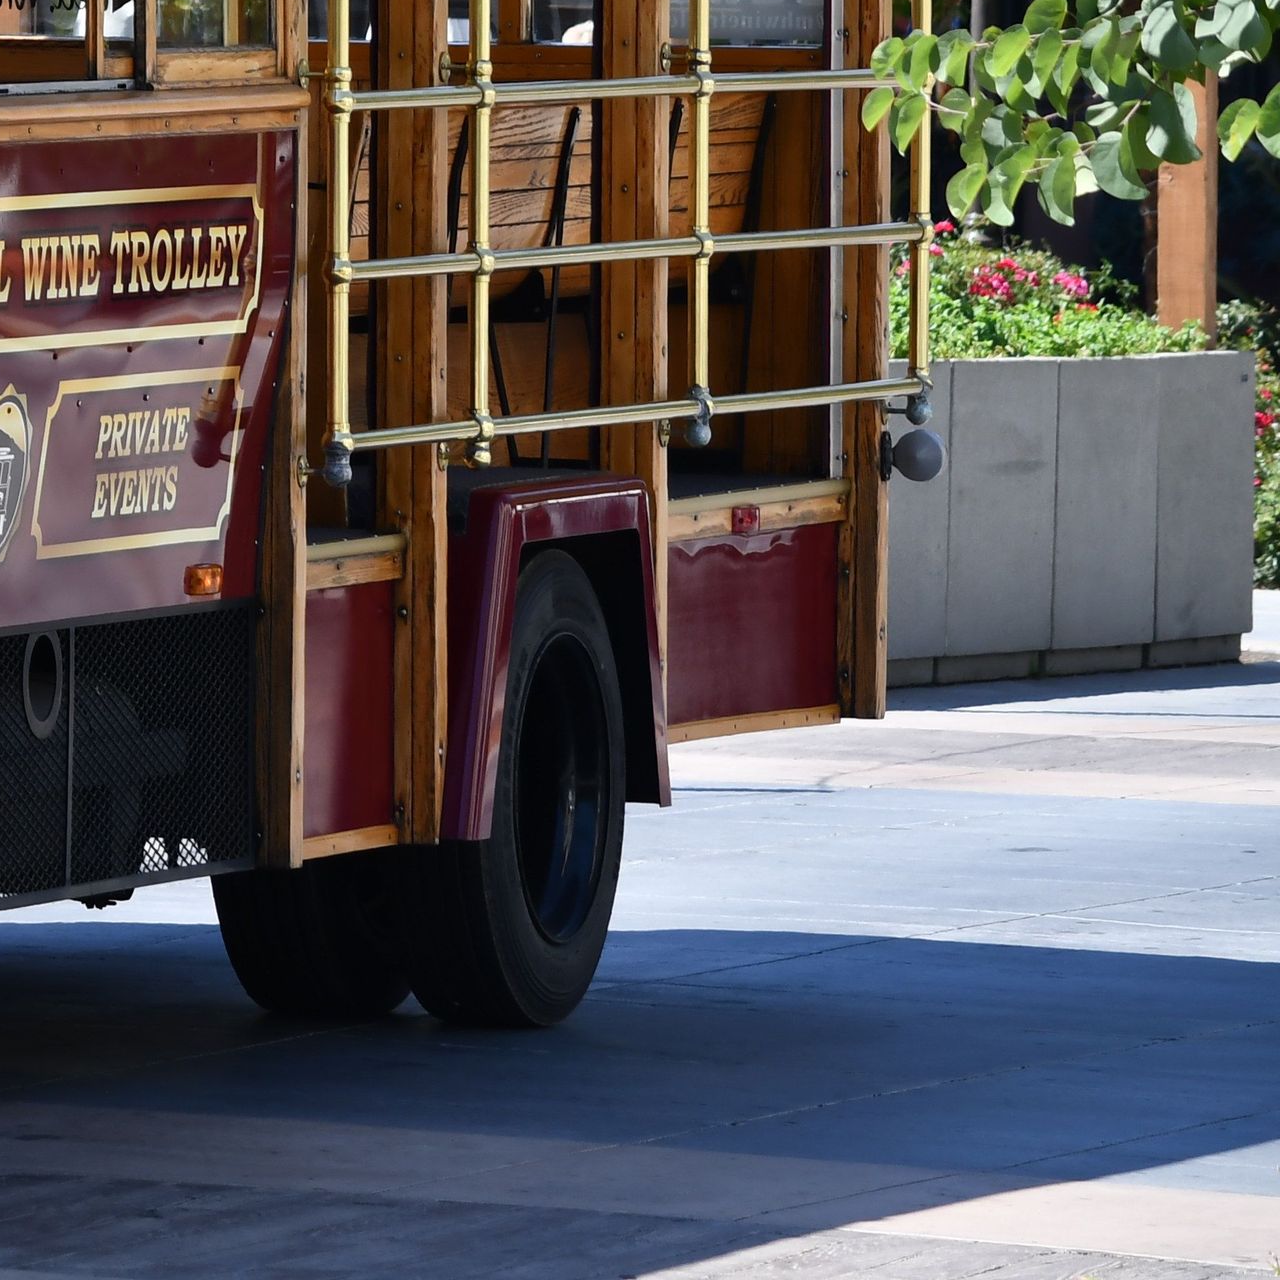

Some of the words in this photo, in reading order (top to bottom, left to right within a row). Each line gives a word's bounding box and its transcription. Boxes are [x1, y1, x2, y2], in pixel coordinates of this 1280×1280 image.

[21, 233, 101, 302] WINE
[110, 225, 247, 294] TROLLEY
[95, 406, 191, 460] PRIVATE
[91, 465, 179, 520] EVENTS
